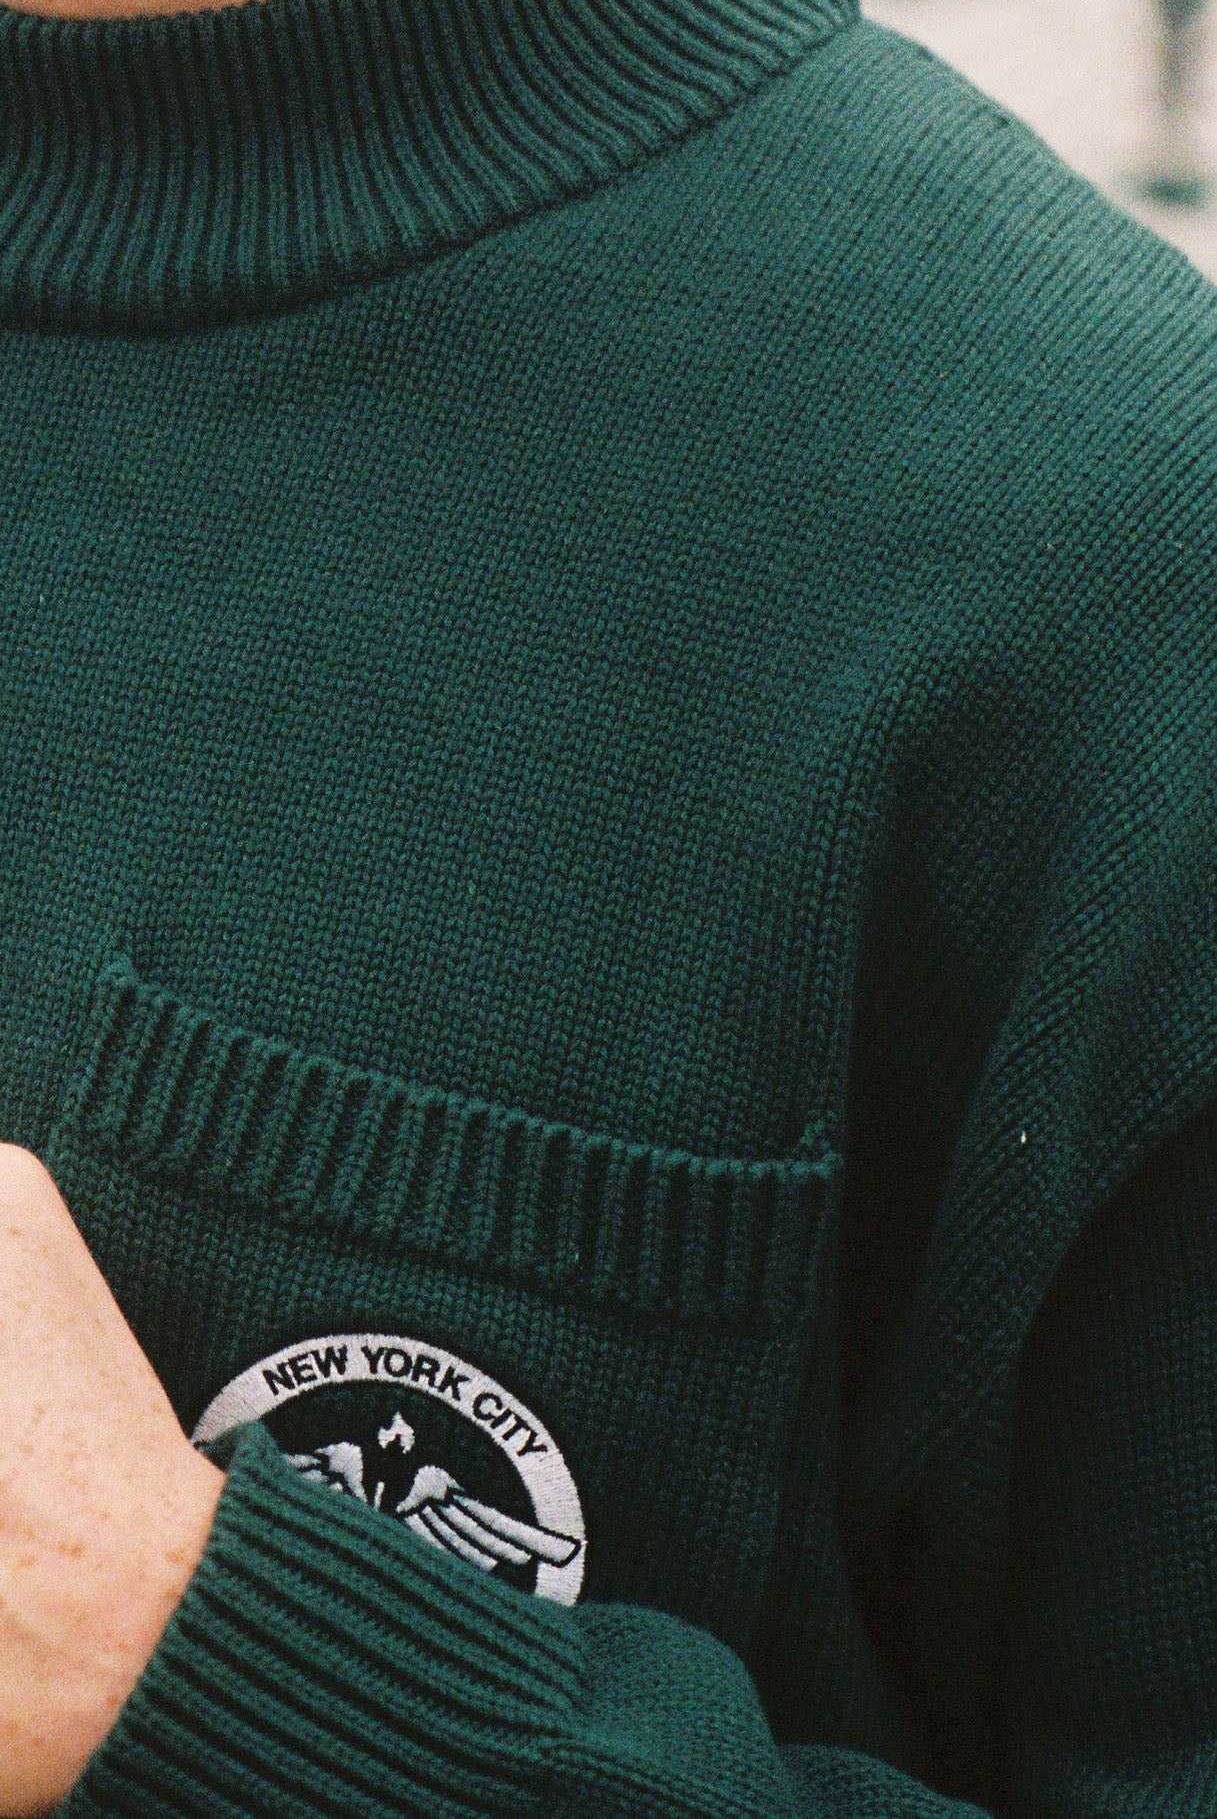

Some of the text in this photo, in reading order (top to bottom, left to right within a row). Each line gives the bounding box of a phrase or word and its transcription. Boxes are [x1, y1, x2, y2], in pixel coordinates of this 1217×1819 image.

[262, 1345, 548, 1457] NEW YORK CITY
